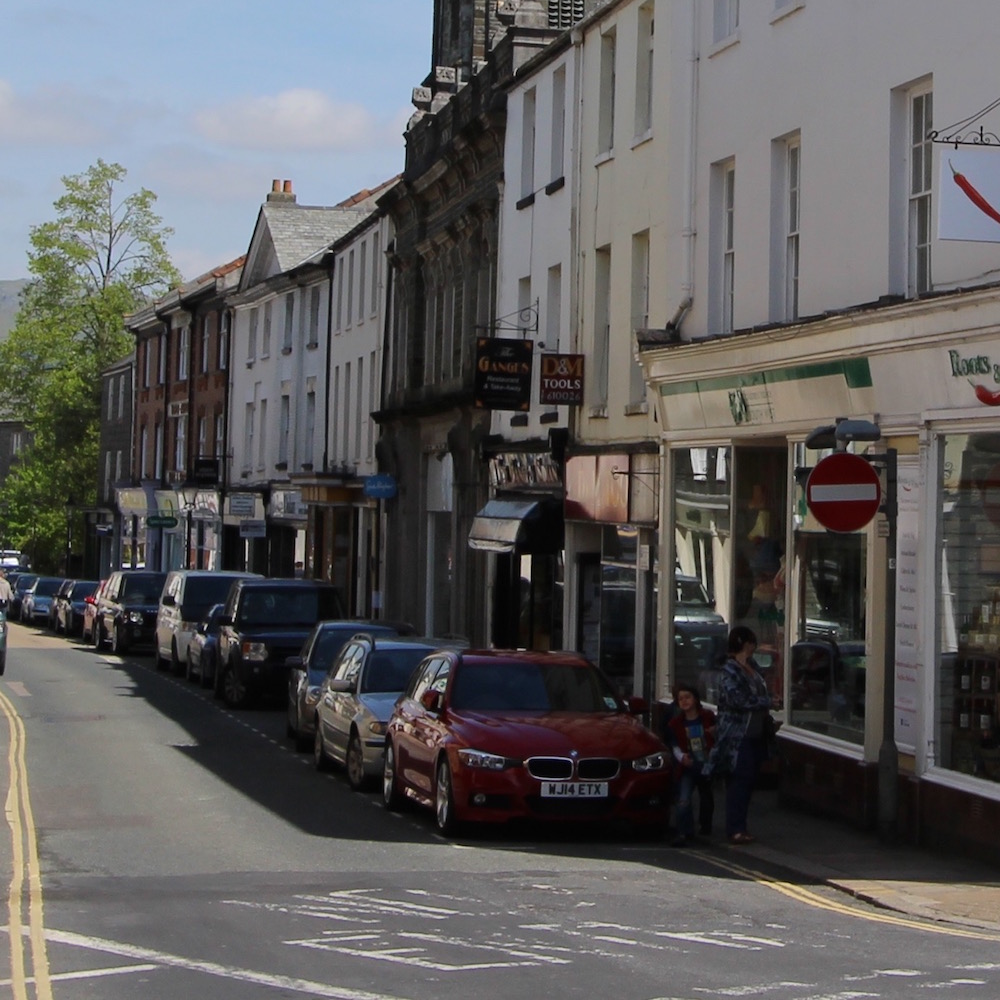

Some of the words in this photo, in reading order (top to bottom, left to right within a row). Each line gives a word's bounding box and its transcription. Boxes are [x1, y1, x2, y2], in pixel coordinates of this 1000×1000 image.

[543, 357, 583, 376] D&M
[948, 349, 991, 377] Roots
[543, 378, 581, 389] TOOLS
[578, 783, 602, 796] ETX
